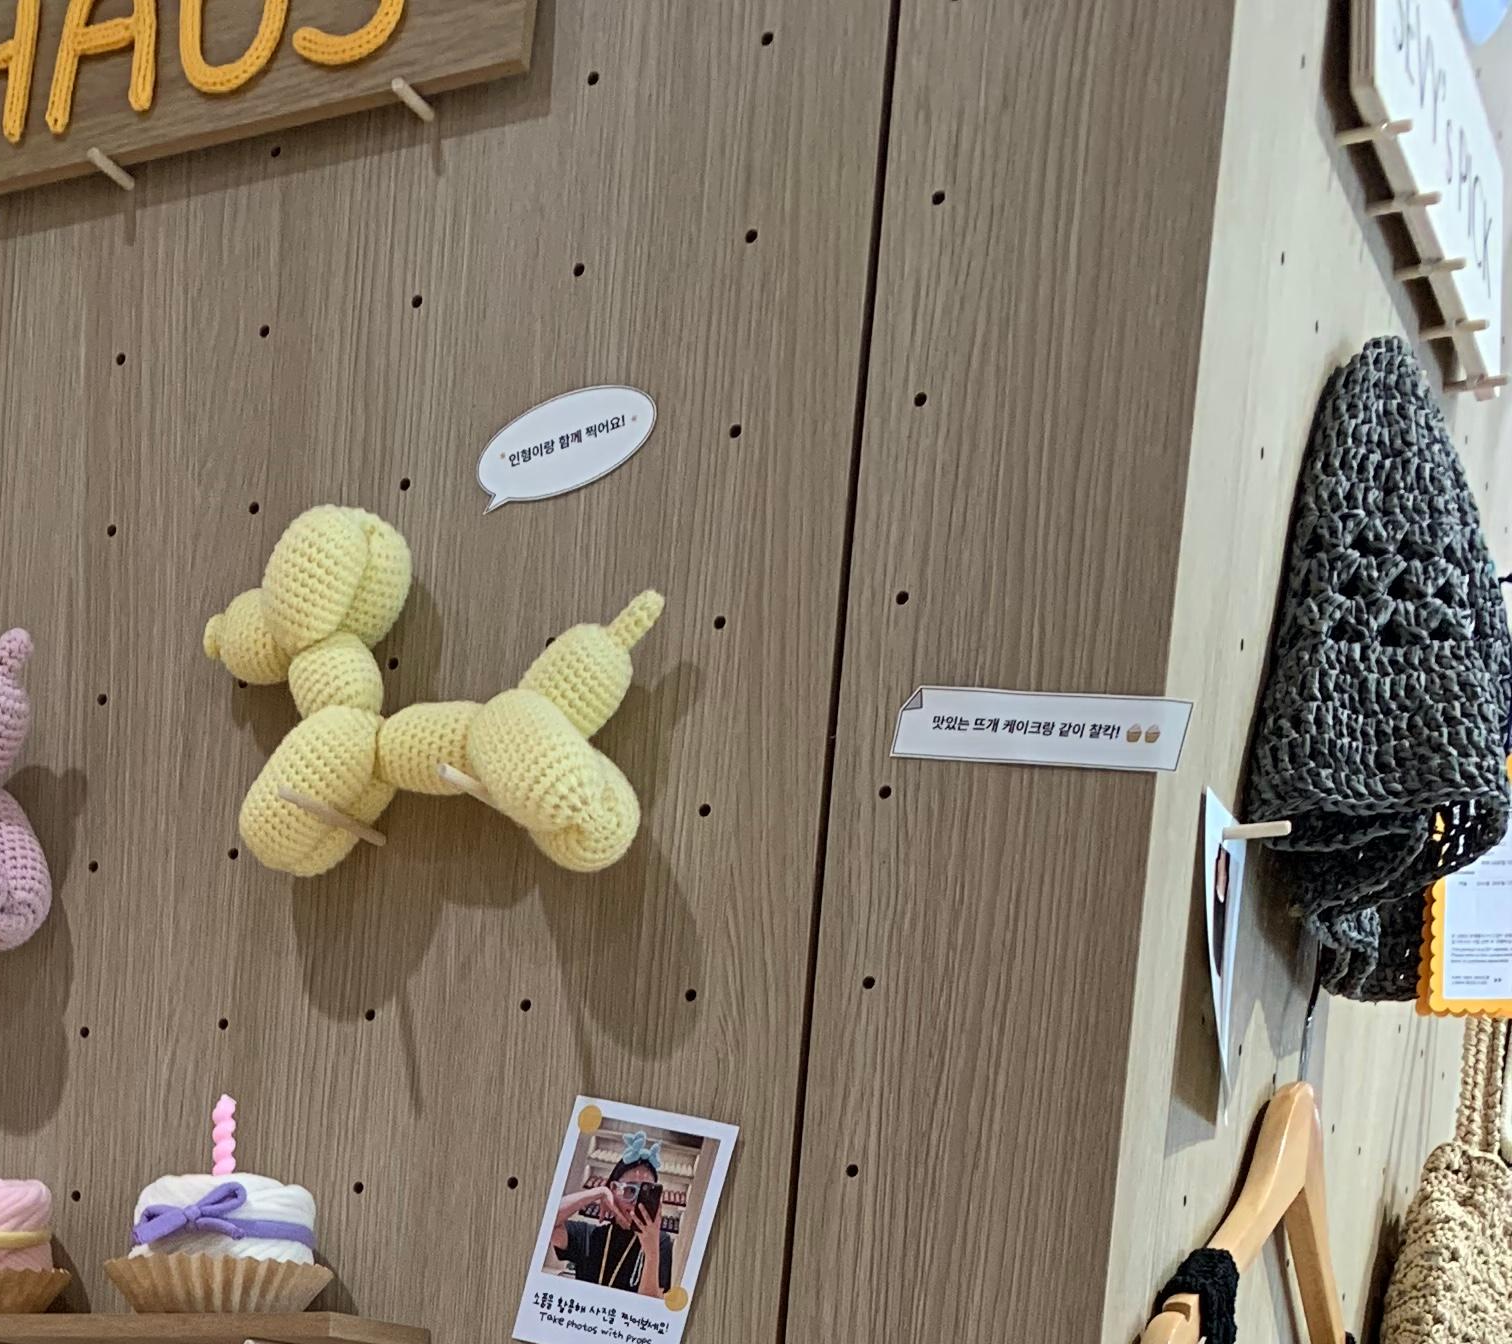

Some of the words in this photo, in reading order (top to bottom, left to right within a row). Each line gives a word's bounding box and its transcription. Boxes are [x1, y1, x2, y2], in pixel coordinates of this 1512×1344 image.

[558, 428, 582, 450] 함께
[585, 414, 625, 438] 찍어요!
[932, 715, 970, 731] 맛있는
[972, 717, 1000, 733] 뜨개
[1001, 719, 1055, 736] 케이크랑
[1058, 722, 1086, 739] 같이
[1088, 723, 1121, 740] 찰칵!
[540, 1312, 565, 1326] Take
[567, 1319, 598, 1334] photos
[601, 1329, 624, 1339] with
[589, 1306, 617, 1325] 사진을
